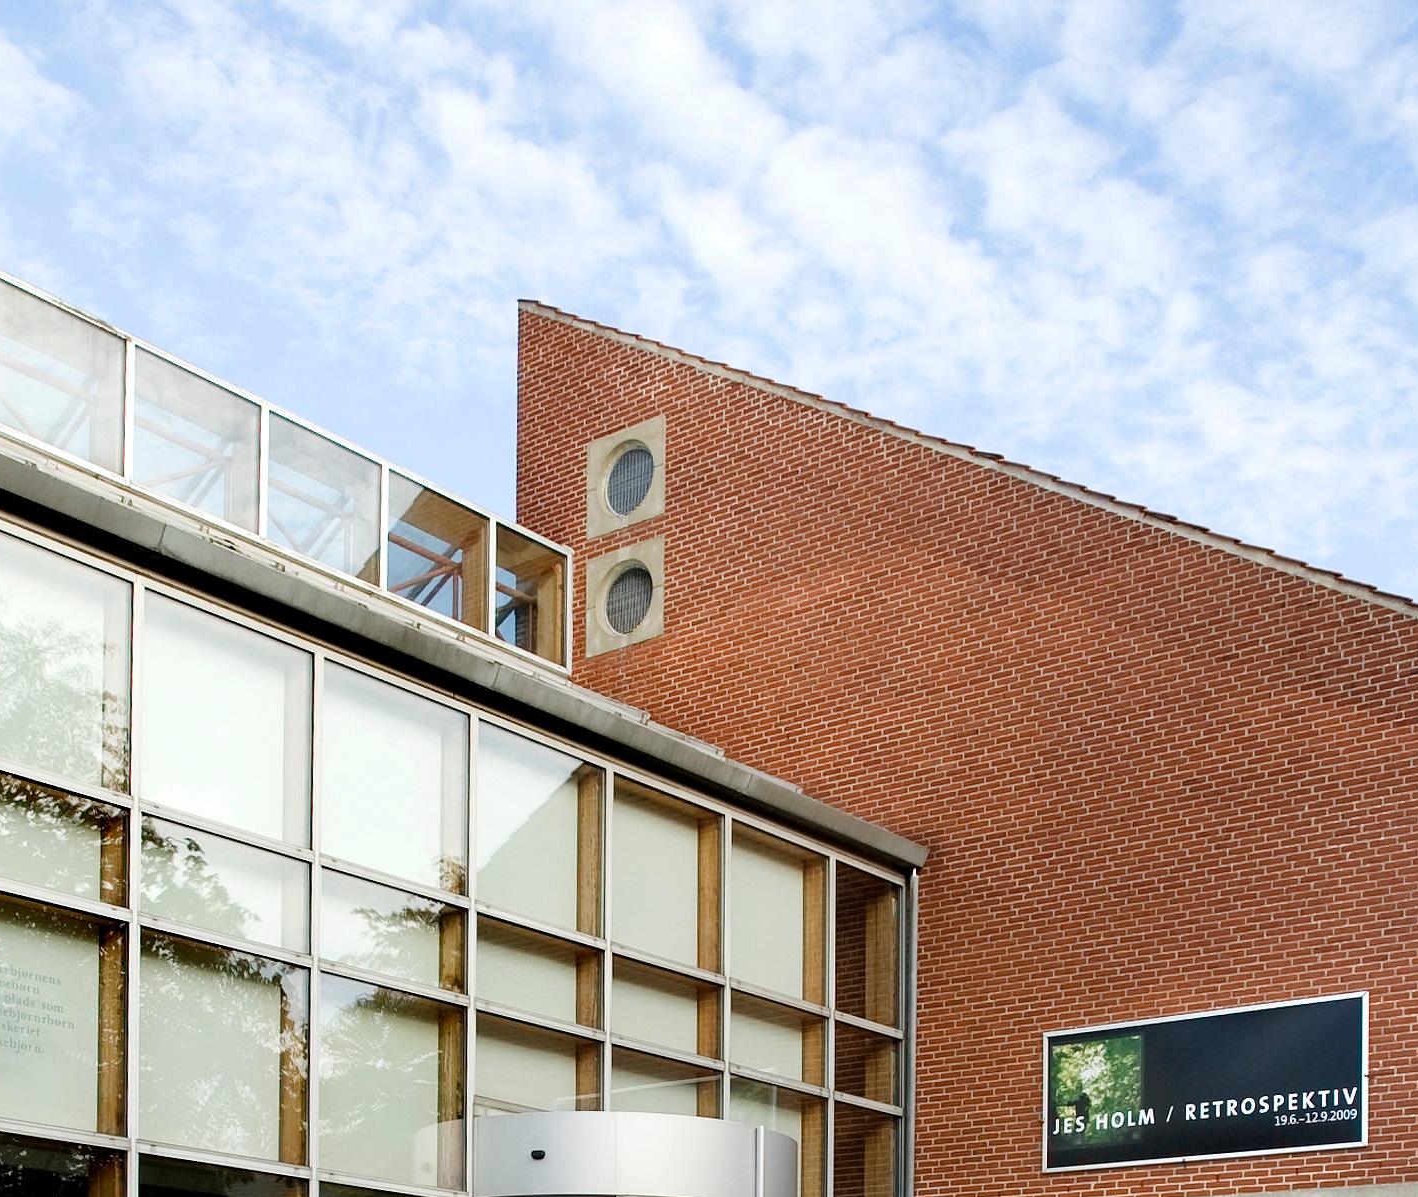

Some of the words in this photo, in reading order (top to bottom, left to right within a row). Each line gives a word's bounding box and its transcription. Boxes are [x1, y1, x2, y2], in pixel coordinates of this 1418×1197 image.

[3, 994, 35, 1009] plads
[41, 1001, 64, 1014] som
[1052, 1115, 1086, 1135] JES
[1095, 1107, 1155, 1130] HOLM
[1166, 1105, 1174, 1123] /
[1185, 1086, 1358, 1121] RETROSPEKTIV
